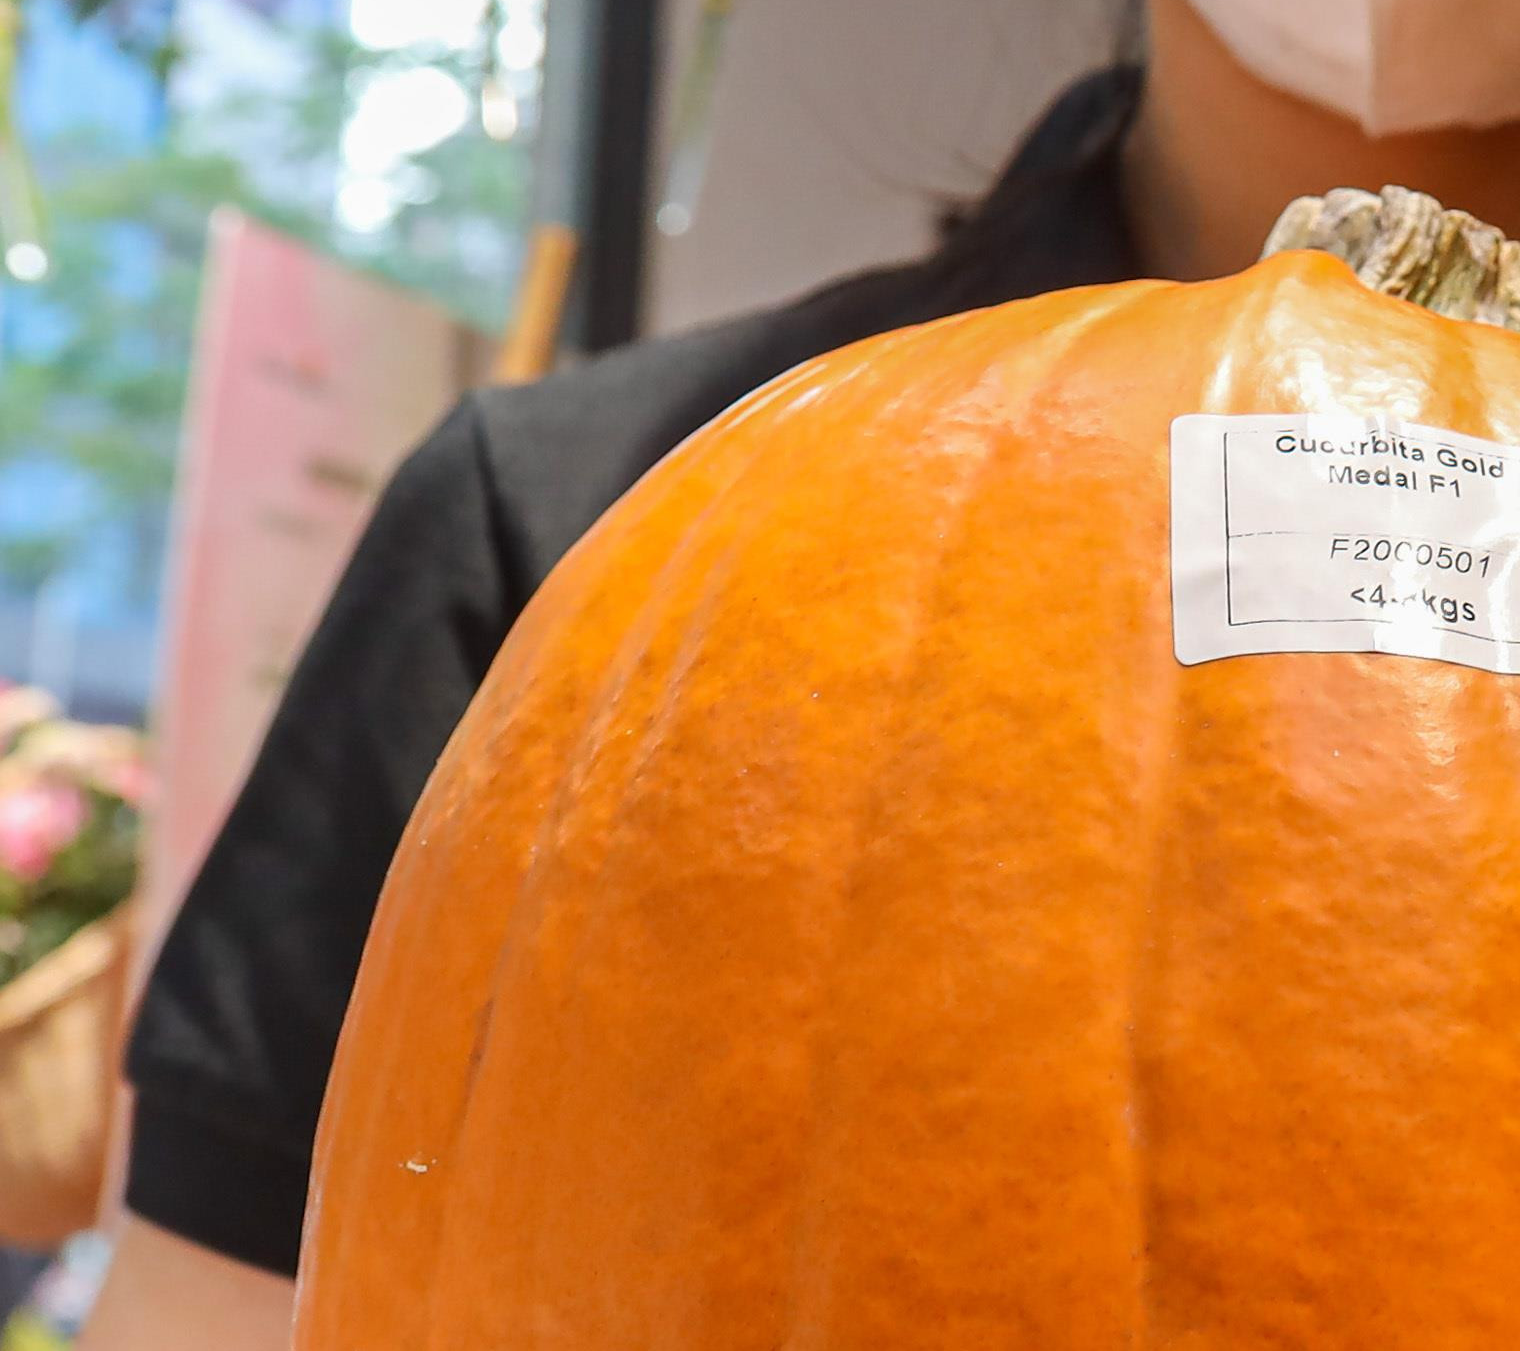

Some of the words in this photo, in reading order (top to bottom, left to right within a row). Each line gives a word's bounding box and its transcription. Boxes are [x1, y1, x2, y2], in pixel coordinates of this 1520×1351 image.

[1437, 449, 1504, 479] Gold
[1329, 464, 1417, 490] Medal
[1429, 474, 1460, 498] F1
